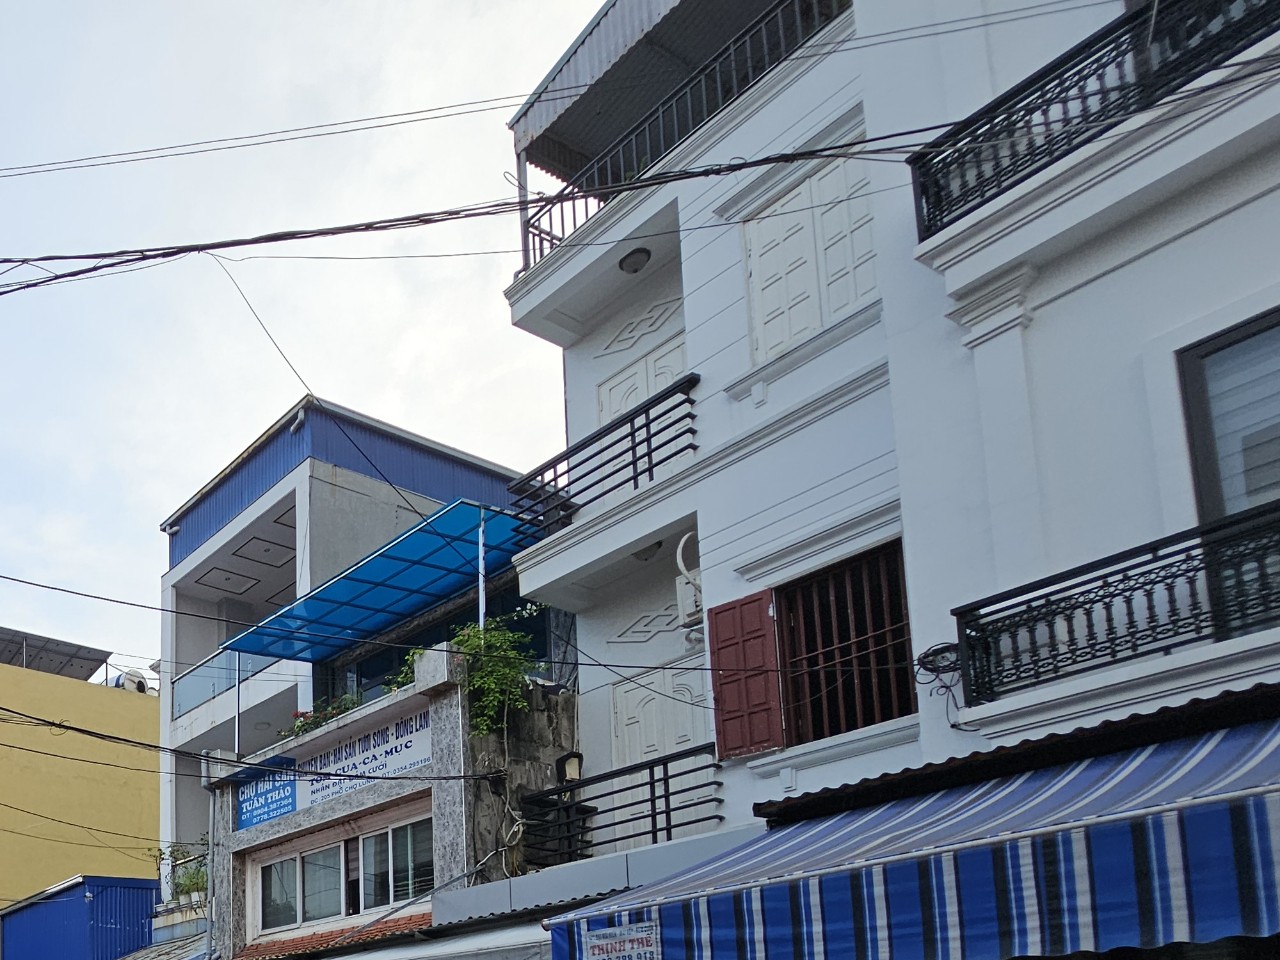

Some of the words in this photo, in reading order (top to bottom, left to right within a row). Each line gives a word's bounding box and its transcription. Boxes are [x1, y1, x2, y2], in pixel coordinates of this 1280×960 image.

[238, 780, 257, 802] CHỢ
[258, 772, 273, 793] HẢI
[267, 786, 292, 803] THẢO
[590, 940, 626, 957] THỊNH
